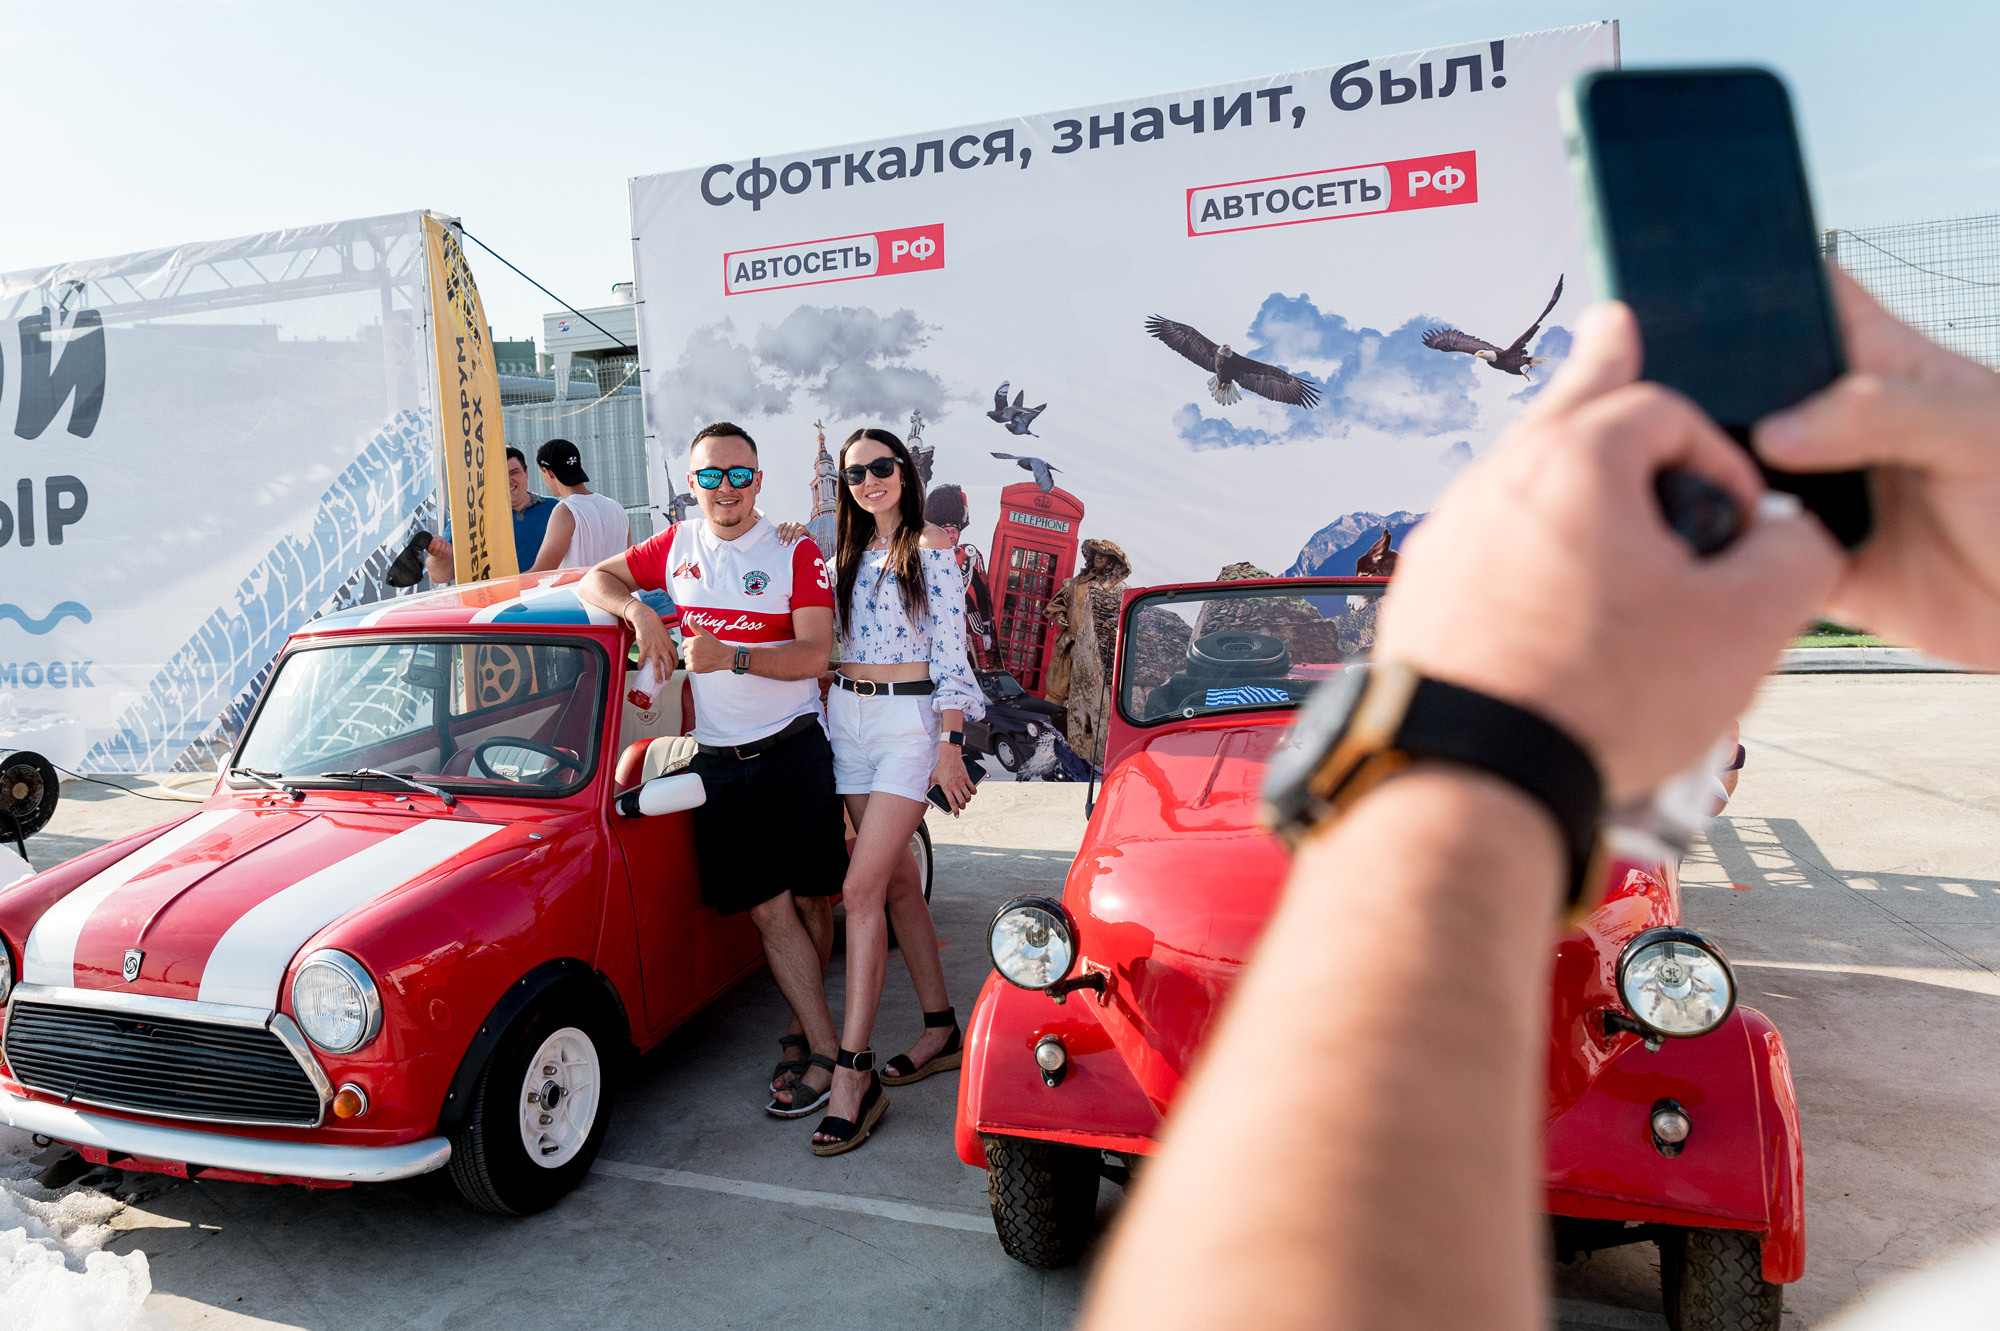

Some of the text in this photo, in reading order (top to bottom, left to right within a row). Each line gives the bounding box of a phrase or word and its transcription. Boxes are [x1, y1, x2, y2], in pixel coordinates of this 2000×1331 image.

[700, 40, 1507, 211] Сфоткался, значит, был!
[1200, 165, 1466, 223] АВТОСЕТЬ РФ
[734, 235, 936, 284] АВТОСЕТЬ РФ
[1012, 511, 1068, 532] TELEPHONE
[681, 611, 766, 634] Nthing Less
